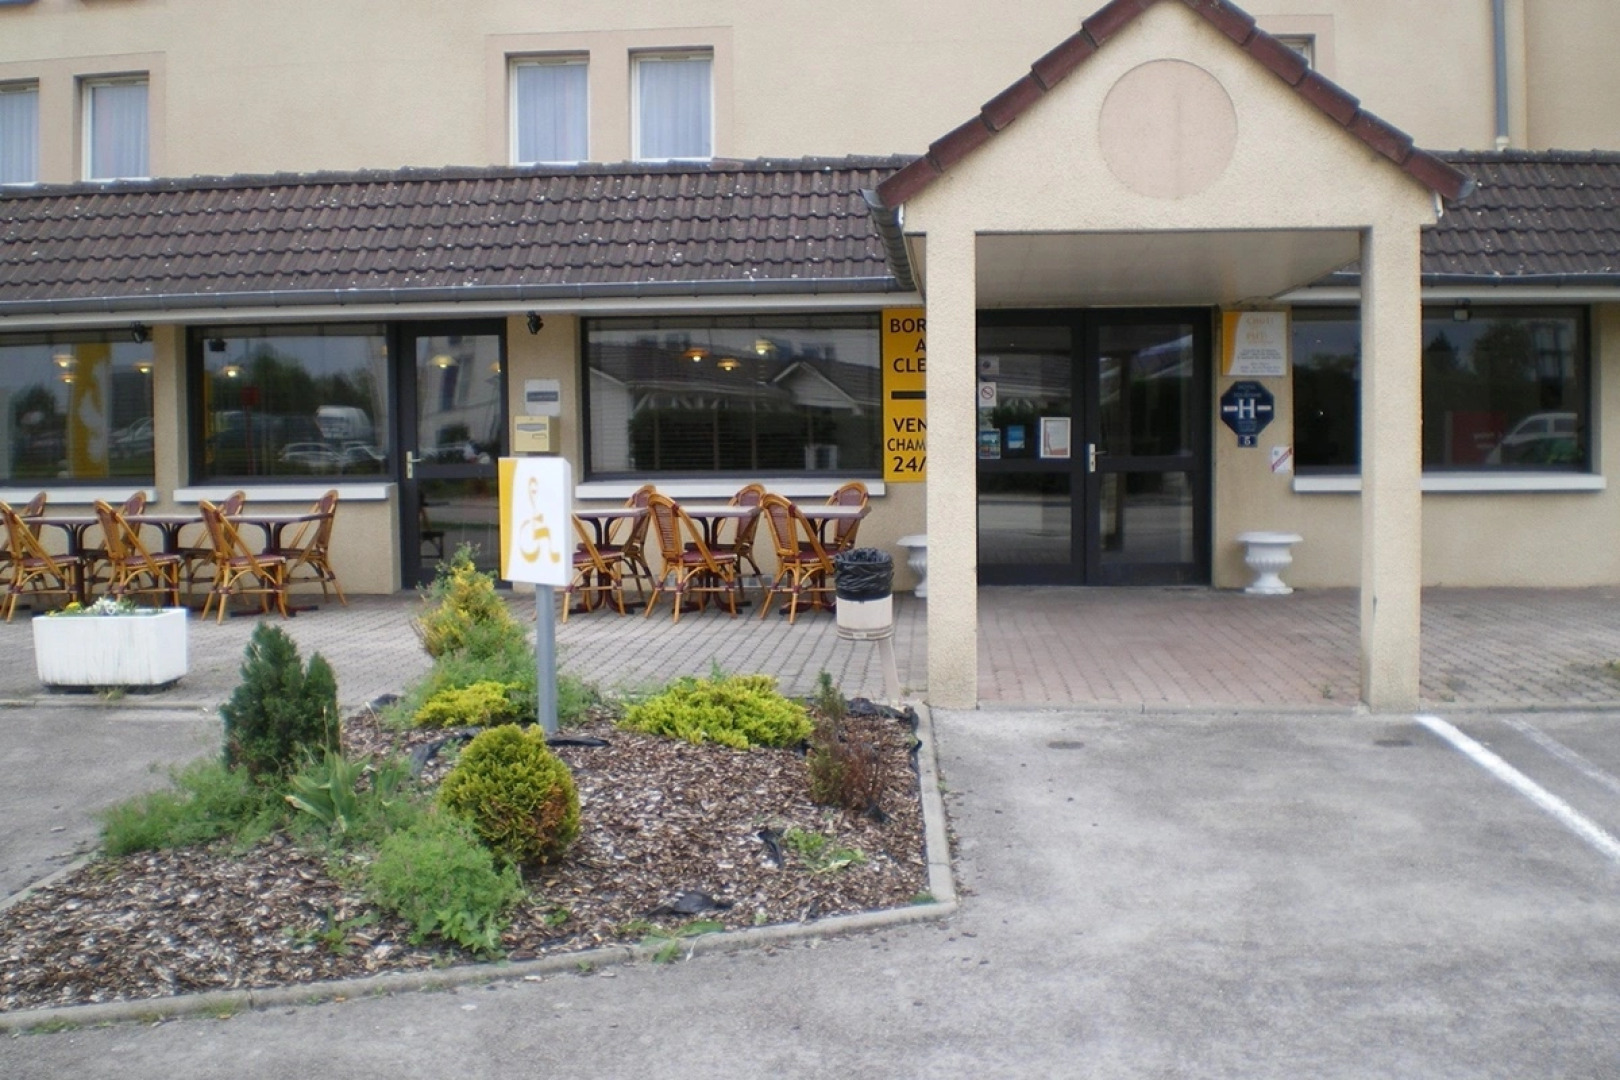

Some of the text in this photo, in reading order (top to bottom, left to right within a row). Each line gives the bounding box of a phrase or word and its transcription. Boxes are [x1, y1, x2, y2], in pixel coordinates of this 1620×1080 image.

[890, 318, 926, 333] BOR
[893, 358, 926, 373] CLE
[1238, 399, 1255, 419] H
